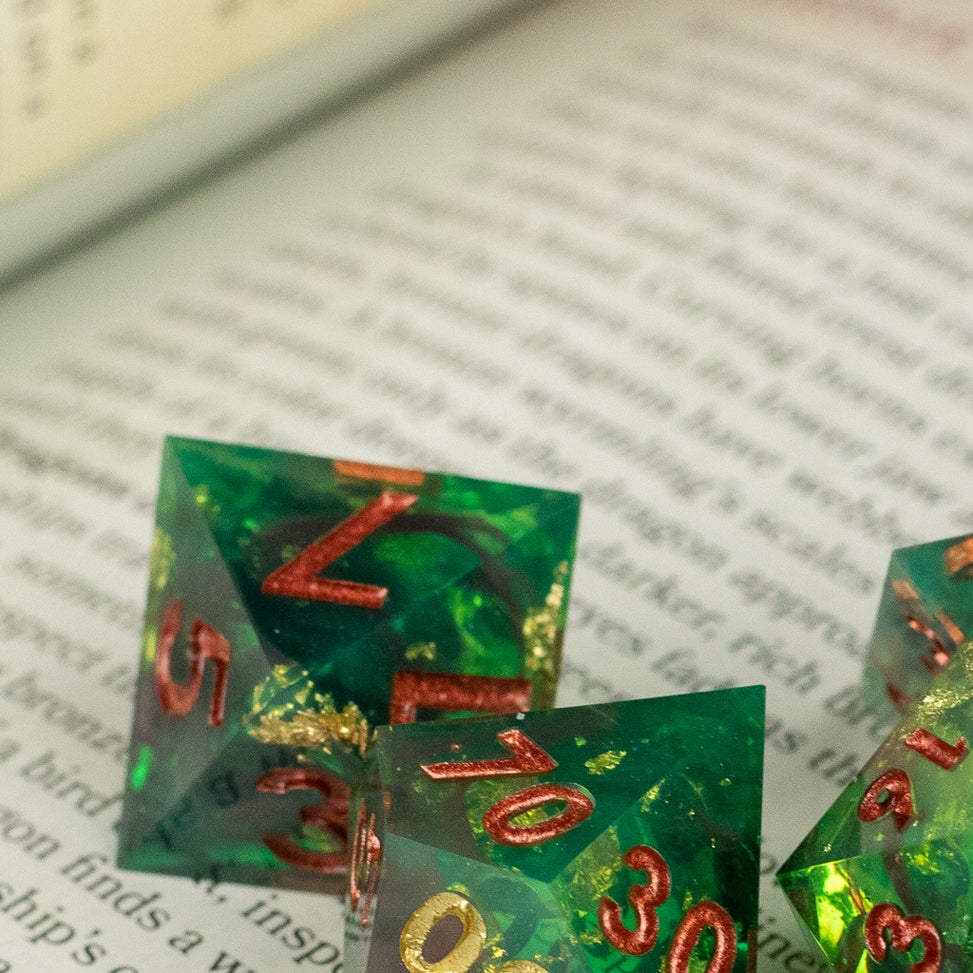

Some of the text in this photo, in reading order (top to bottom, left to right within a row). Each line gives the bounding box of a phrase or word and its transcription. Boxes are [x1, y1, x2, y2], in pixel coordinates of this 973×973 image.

[729, 632, 822, 695] rich
[20, 750, 126, 820] bird
[419, 726, 597, 848] 10
[59, 852, 172, 932] finds
[168, 929, 206, 957] a
